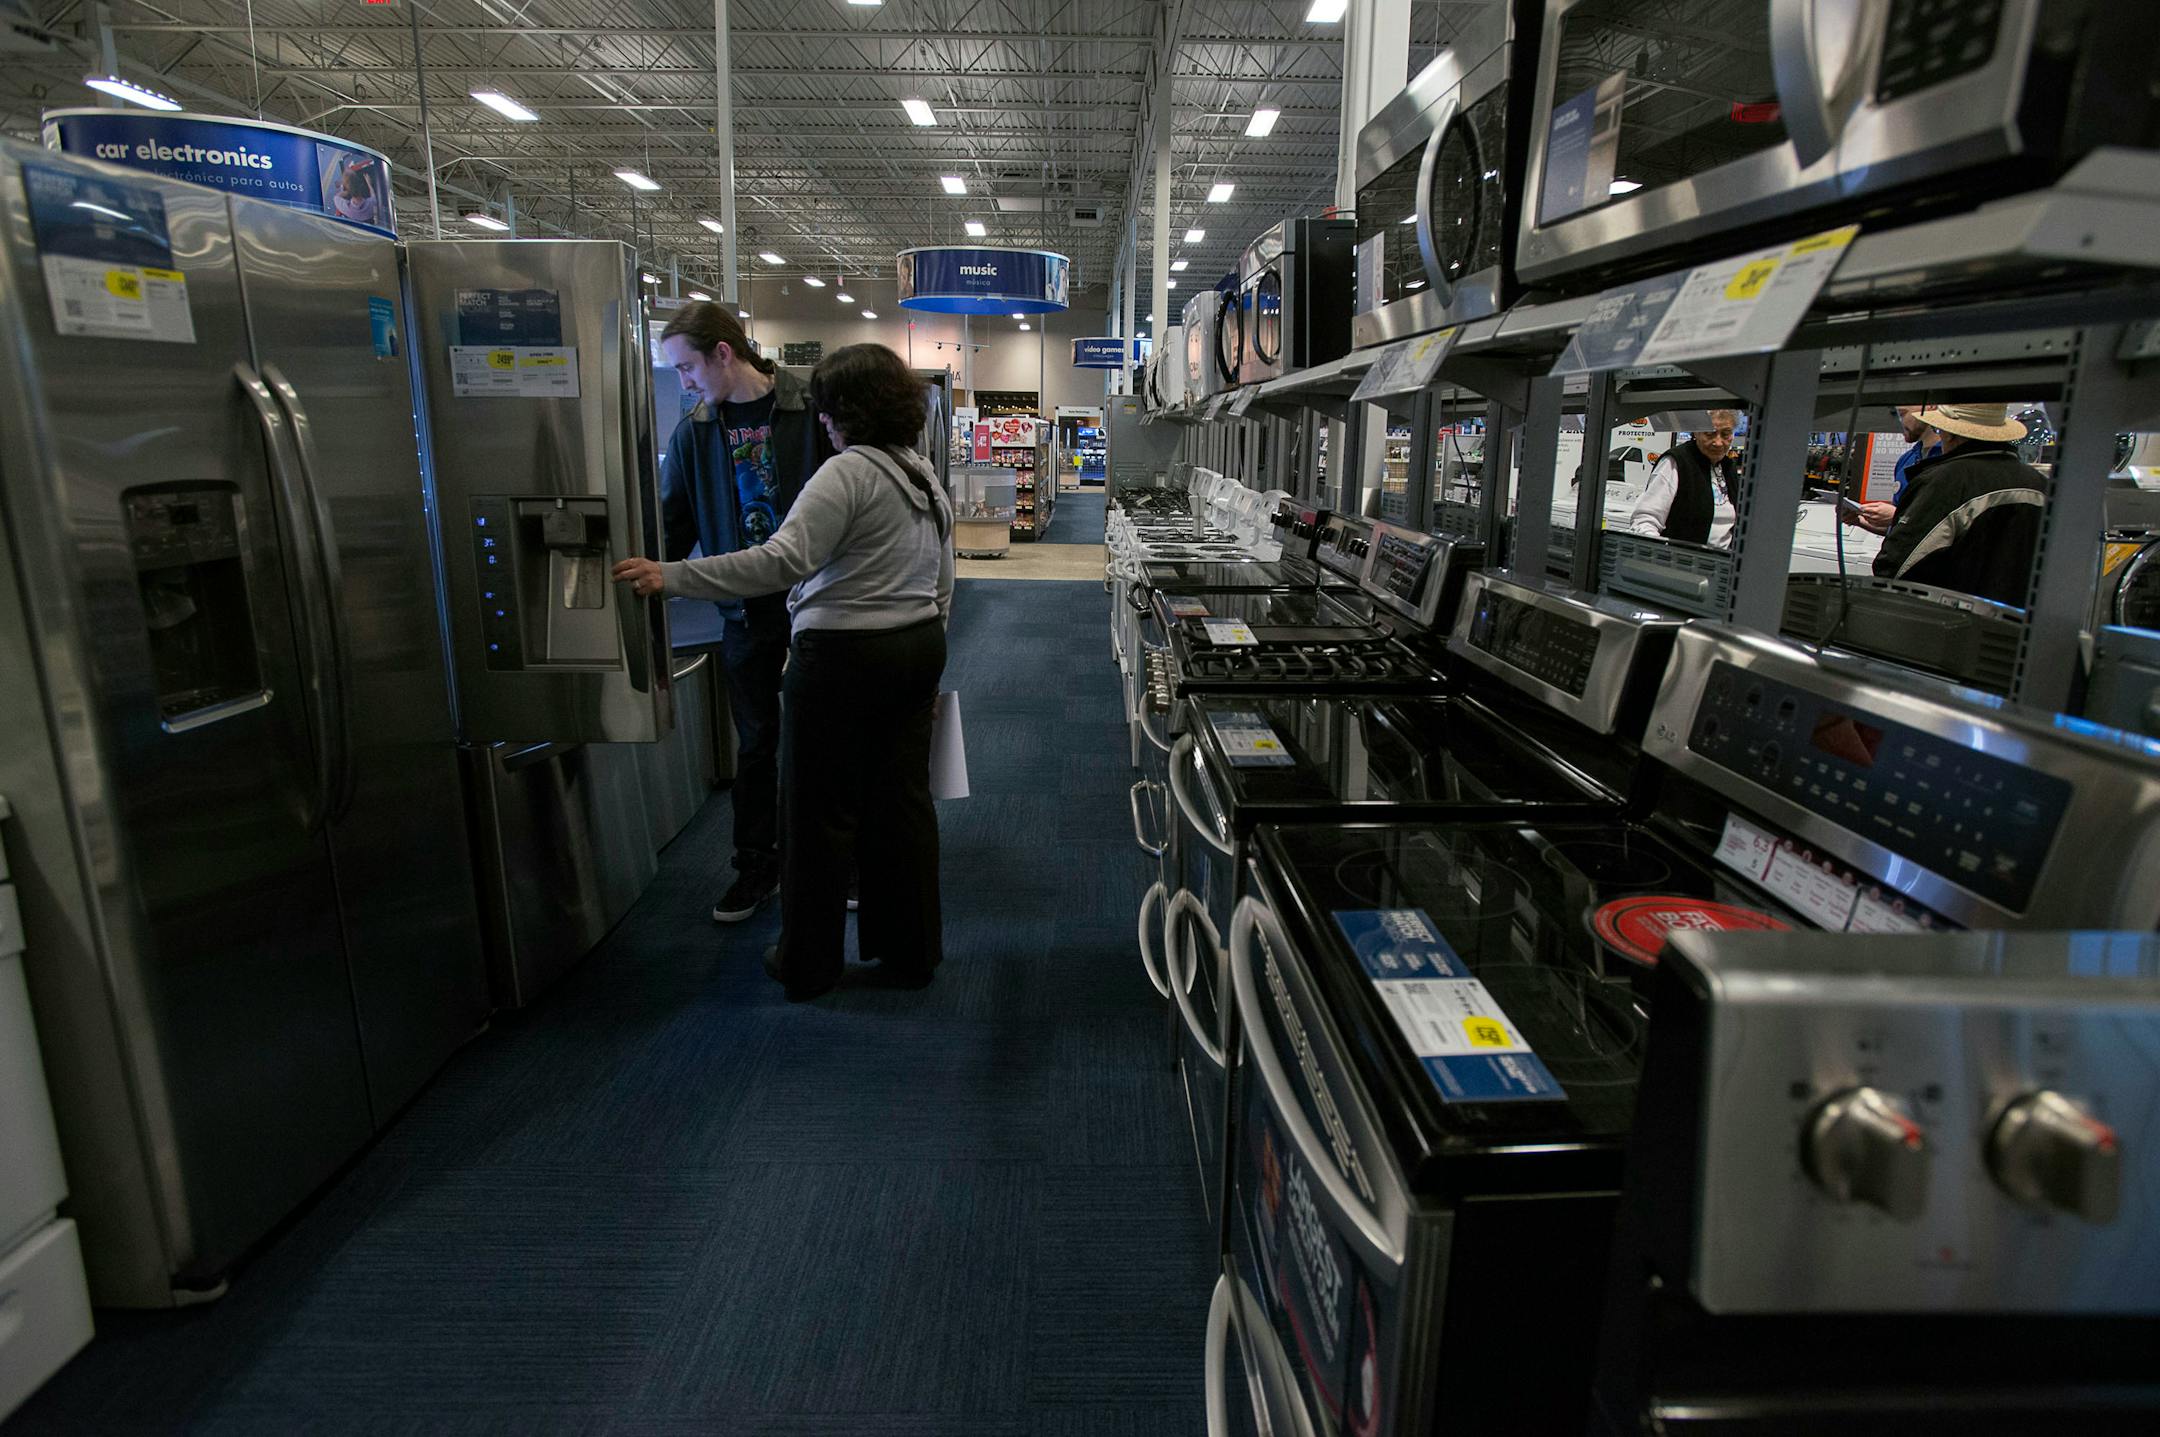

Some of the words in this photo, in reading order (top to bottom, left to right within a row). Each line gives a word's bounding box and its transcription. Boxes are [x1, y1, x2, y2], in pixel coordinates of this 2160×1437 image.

[96, 142, 129, 159] car
[136, 138, 273, 170] electronics
[152, 168, 224, 184] lectrónica
[230, 176, 263, 187] para
[269, 181, 305, 192] autos
[959, 262, 997, 276] music
[1084, 345, 1101, 353] video
